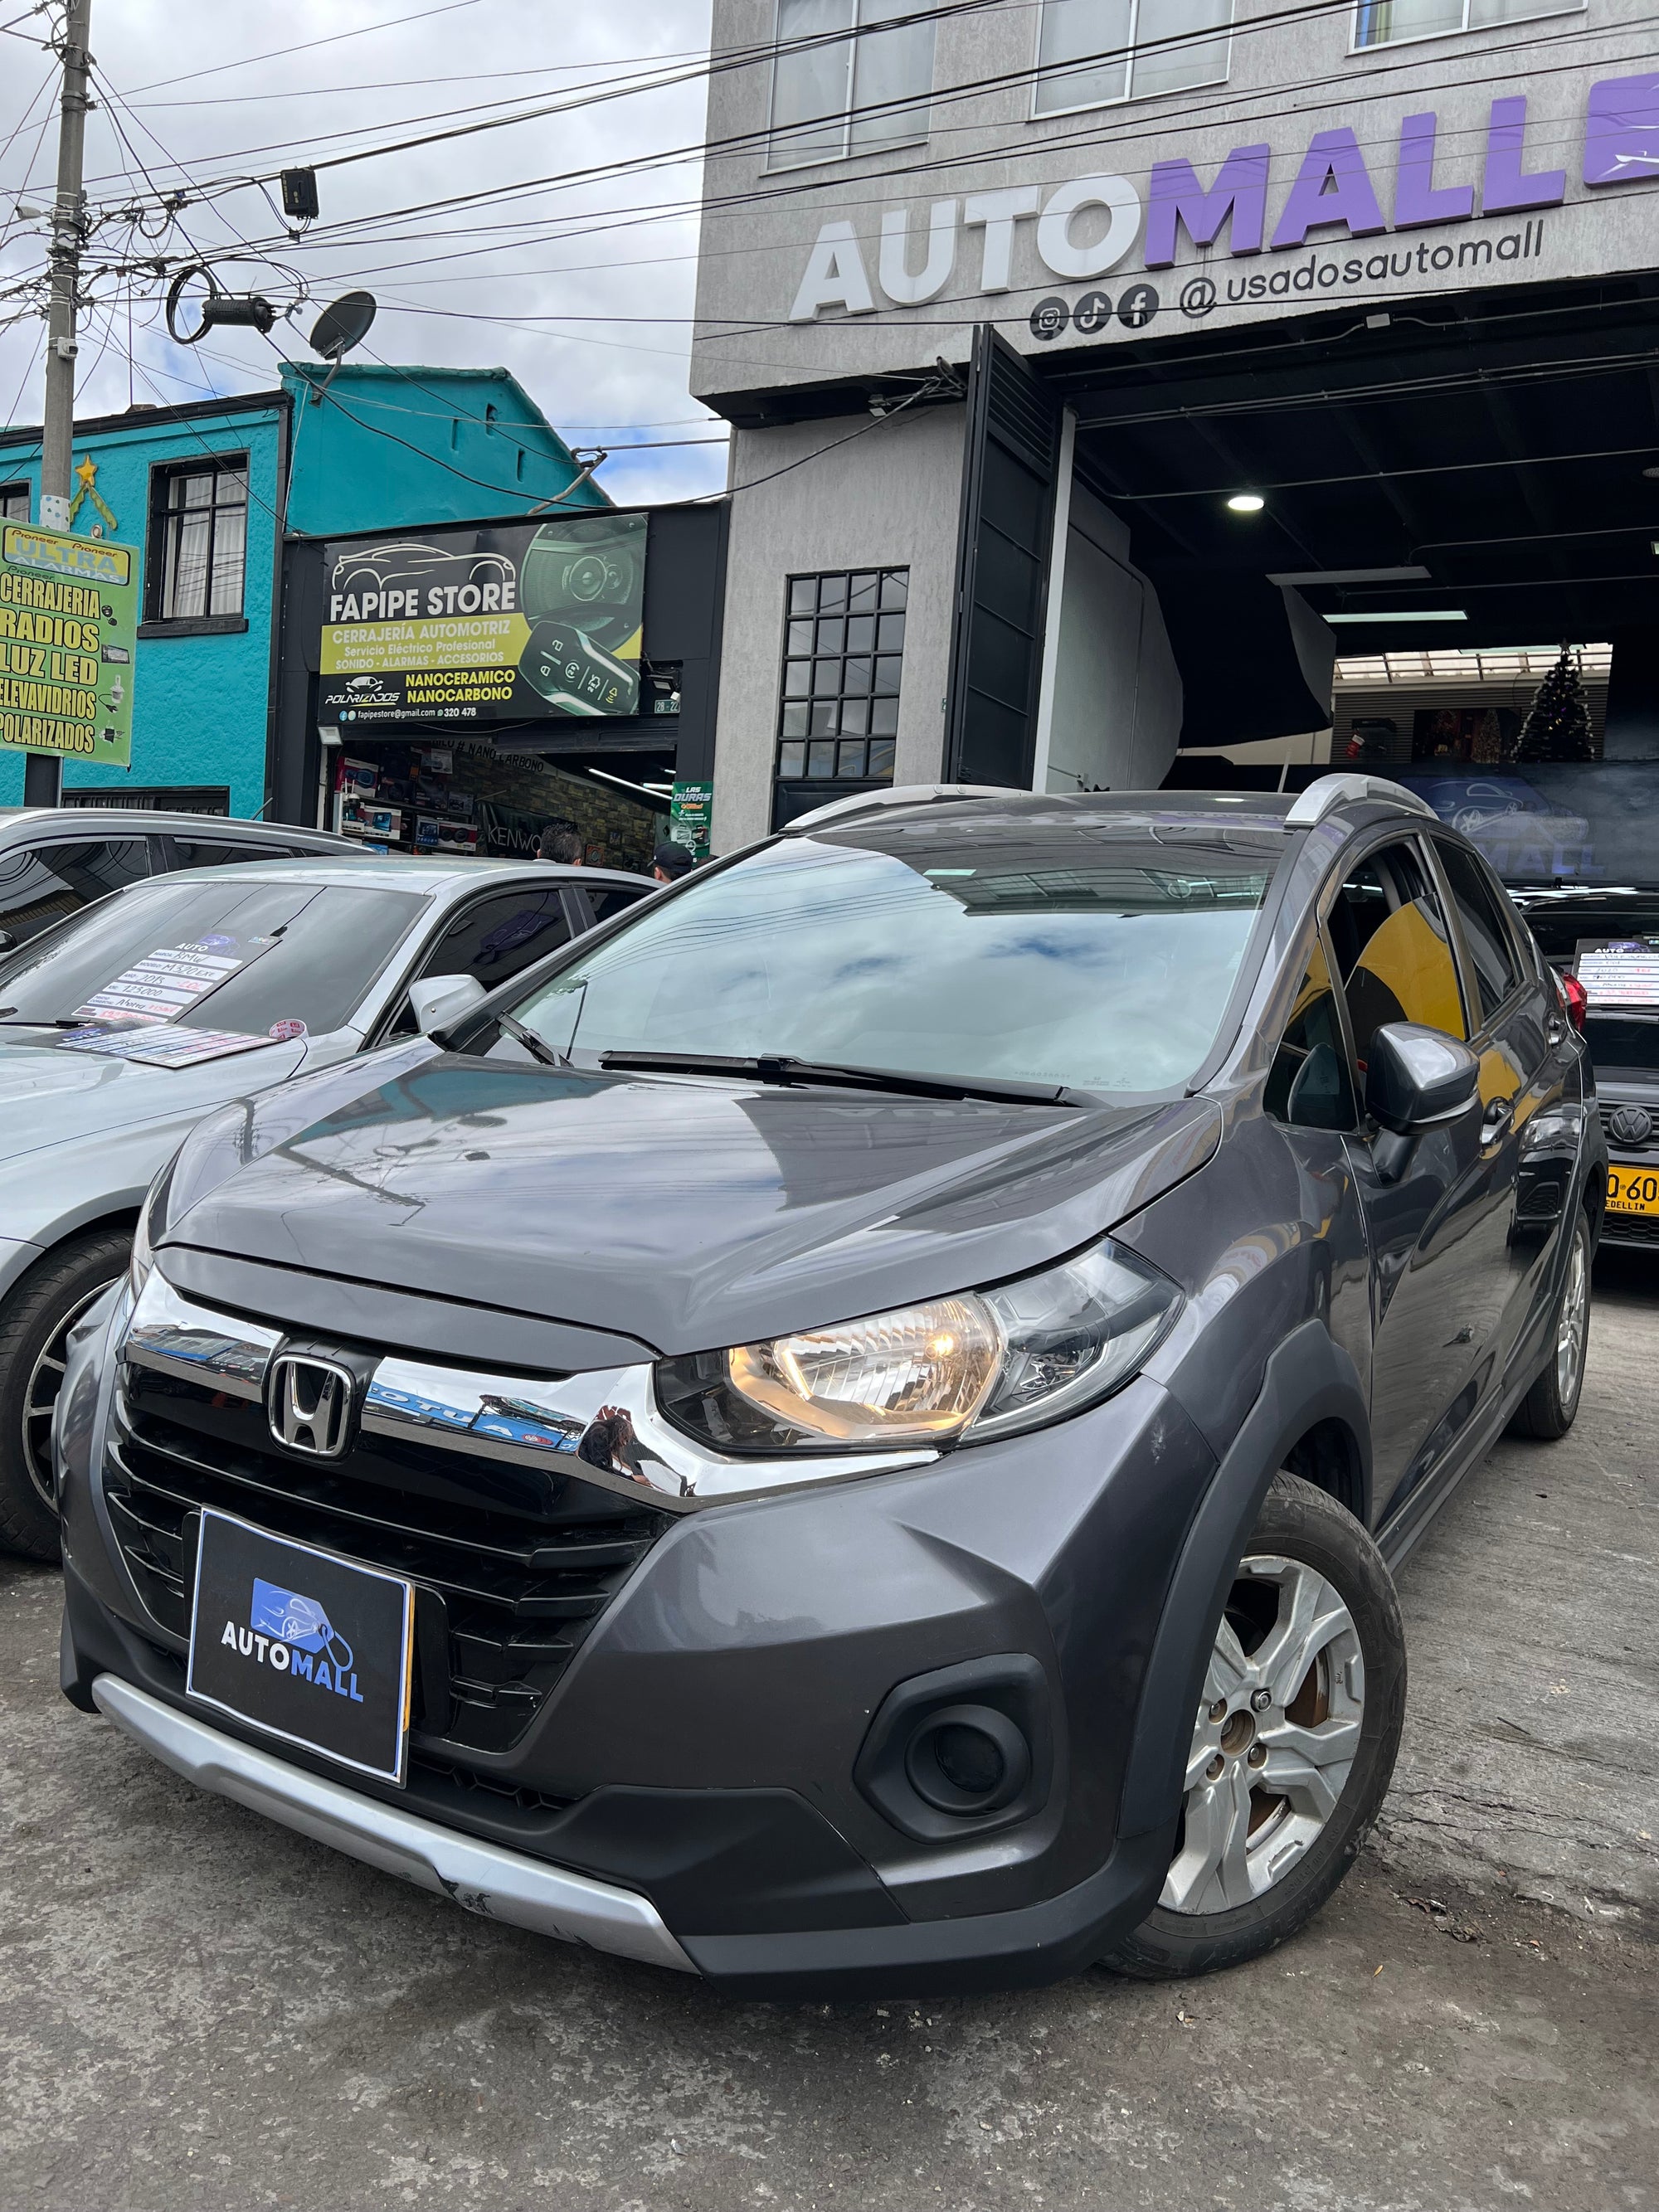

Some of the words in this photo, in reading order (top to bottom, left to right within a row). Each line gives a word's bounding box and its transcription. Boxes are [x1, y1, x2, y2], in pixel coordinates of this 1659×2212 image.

[788, 94, 1565, 324] AUTOMALL
[12, 529, 59, 545] Pioneer
[71, 542, 118, 558] Pioneer
[15, 538, 118, 573] ULTRA
[7, 564, 56, 581] Pioneer
[12, 556, 121, 583] ALARMAS
[0, 572, 100, 620] CERRAJERIA
[330, 588, 419, 621] FAPIPE
[427, 581, 516, 615] STORE
[0, 607, 100, 653] RADIOS
[333, 624, 415, 644] CERRAJERÍA
[420, 620, 510, 639] AUTOMOTRIZ
[344, 645, 385, 657] Servicio
[388, 643, 433, 654] Eléctrico
[436, 639, 495, 652] Profesional
[0, 644, 46, 678] LUZ
[51, 651, 98, 686] LED
[335, 659, 373, 670] SONIDO
[382, 655, 429, 668] ALARMAS
[437, 652, 504, 664] ACCESORIOS
[405, 668, 516, 688] NANOCERAMICO
[325, 692, 401, 704] POLARIZADOS
[406, 687, 513, 703] NANOCARBONO
[358, 708, 435, 720] fapipestore@gmail.com
[444, 707, 460, 717] 320
[461, 707, 477, 717] 478
[469, 742, 497, 761] NANO
[674, 793, 712, 802] DURAS
[489, 824, 540, 853] KENWO
[173, 951, 209, 964] BMW
[1605, 1199, 1645, 1211] EDELLIN
[221, 1621, 364, 1703] AUTOMALL
